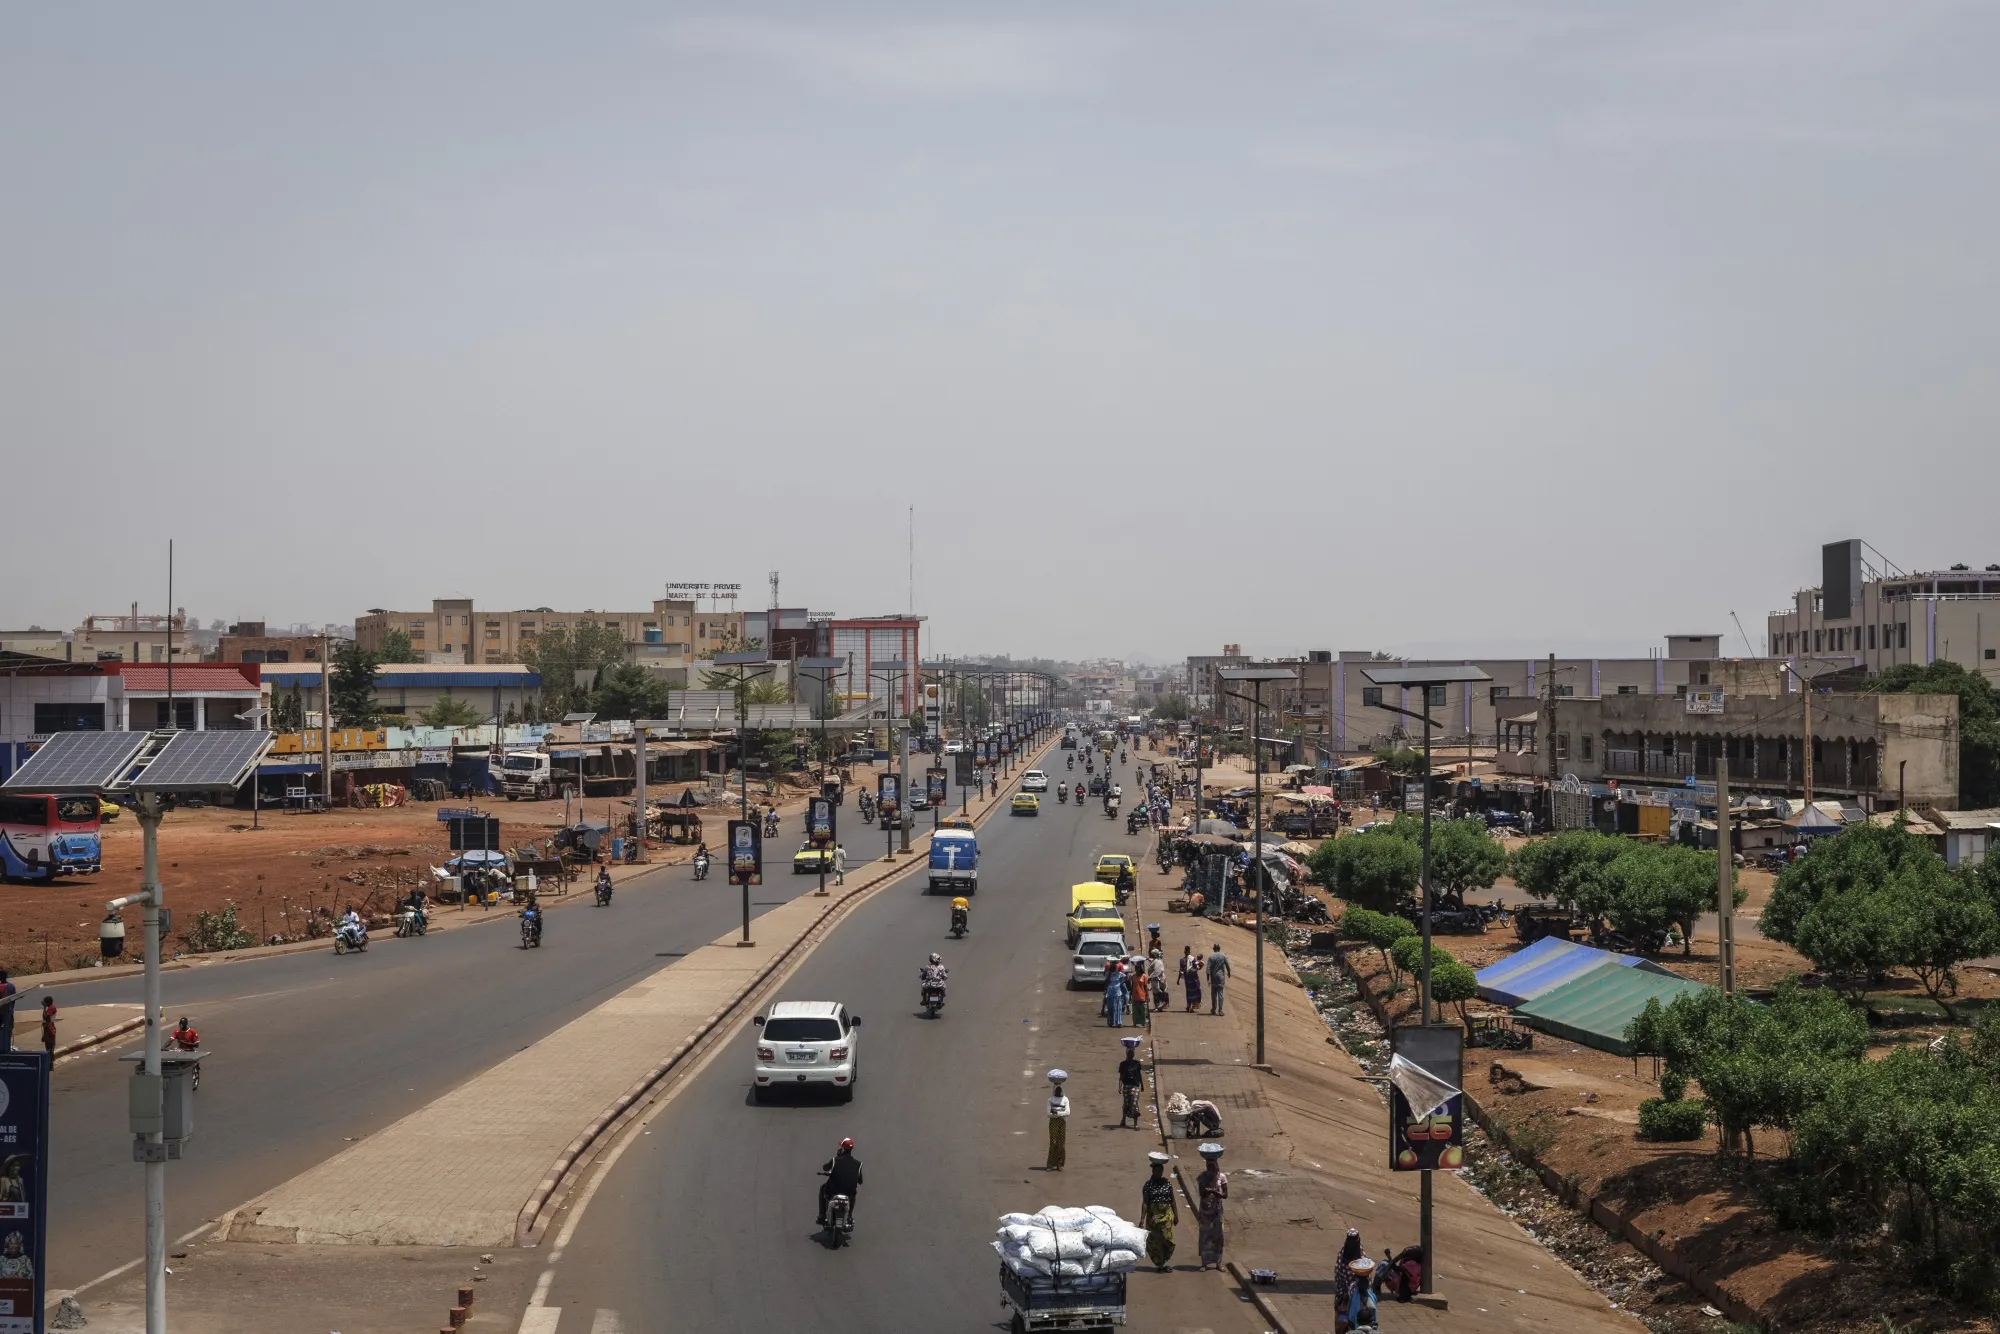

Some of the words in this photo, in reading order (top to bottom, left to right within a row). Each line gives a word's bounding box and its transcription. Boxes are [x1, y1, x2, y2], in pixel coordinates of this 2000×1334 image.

[735, 853, 754, 861] 20
[8, 1125, 17, 1133] DE
[3, 1134, 17, 1143] AES
